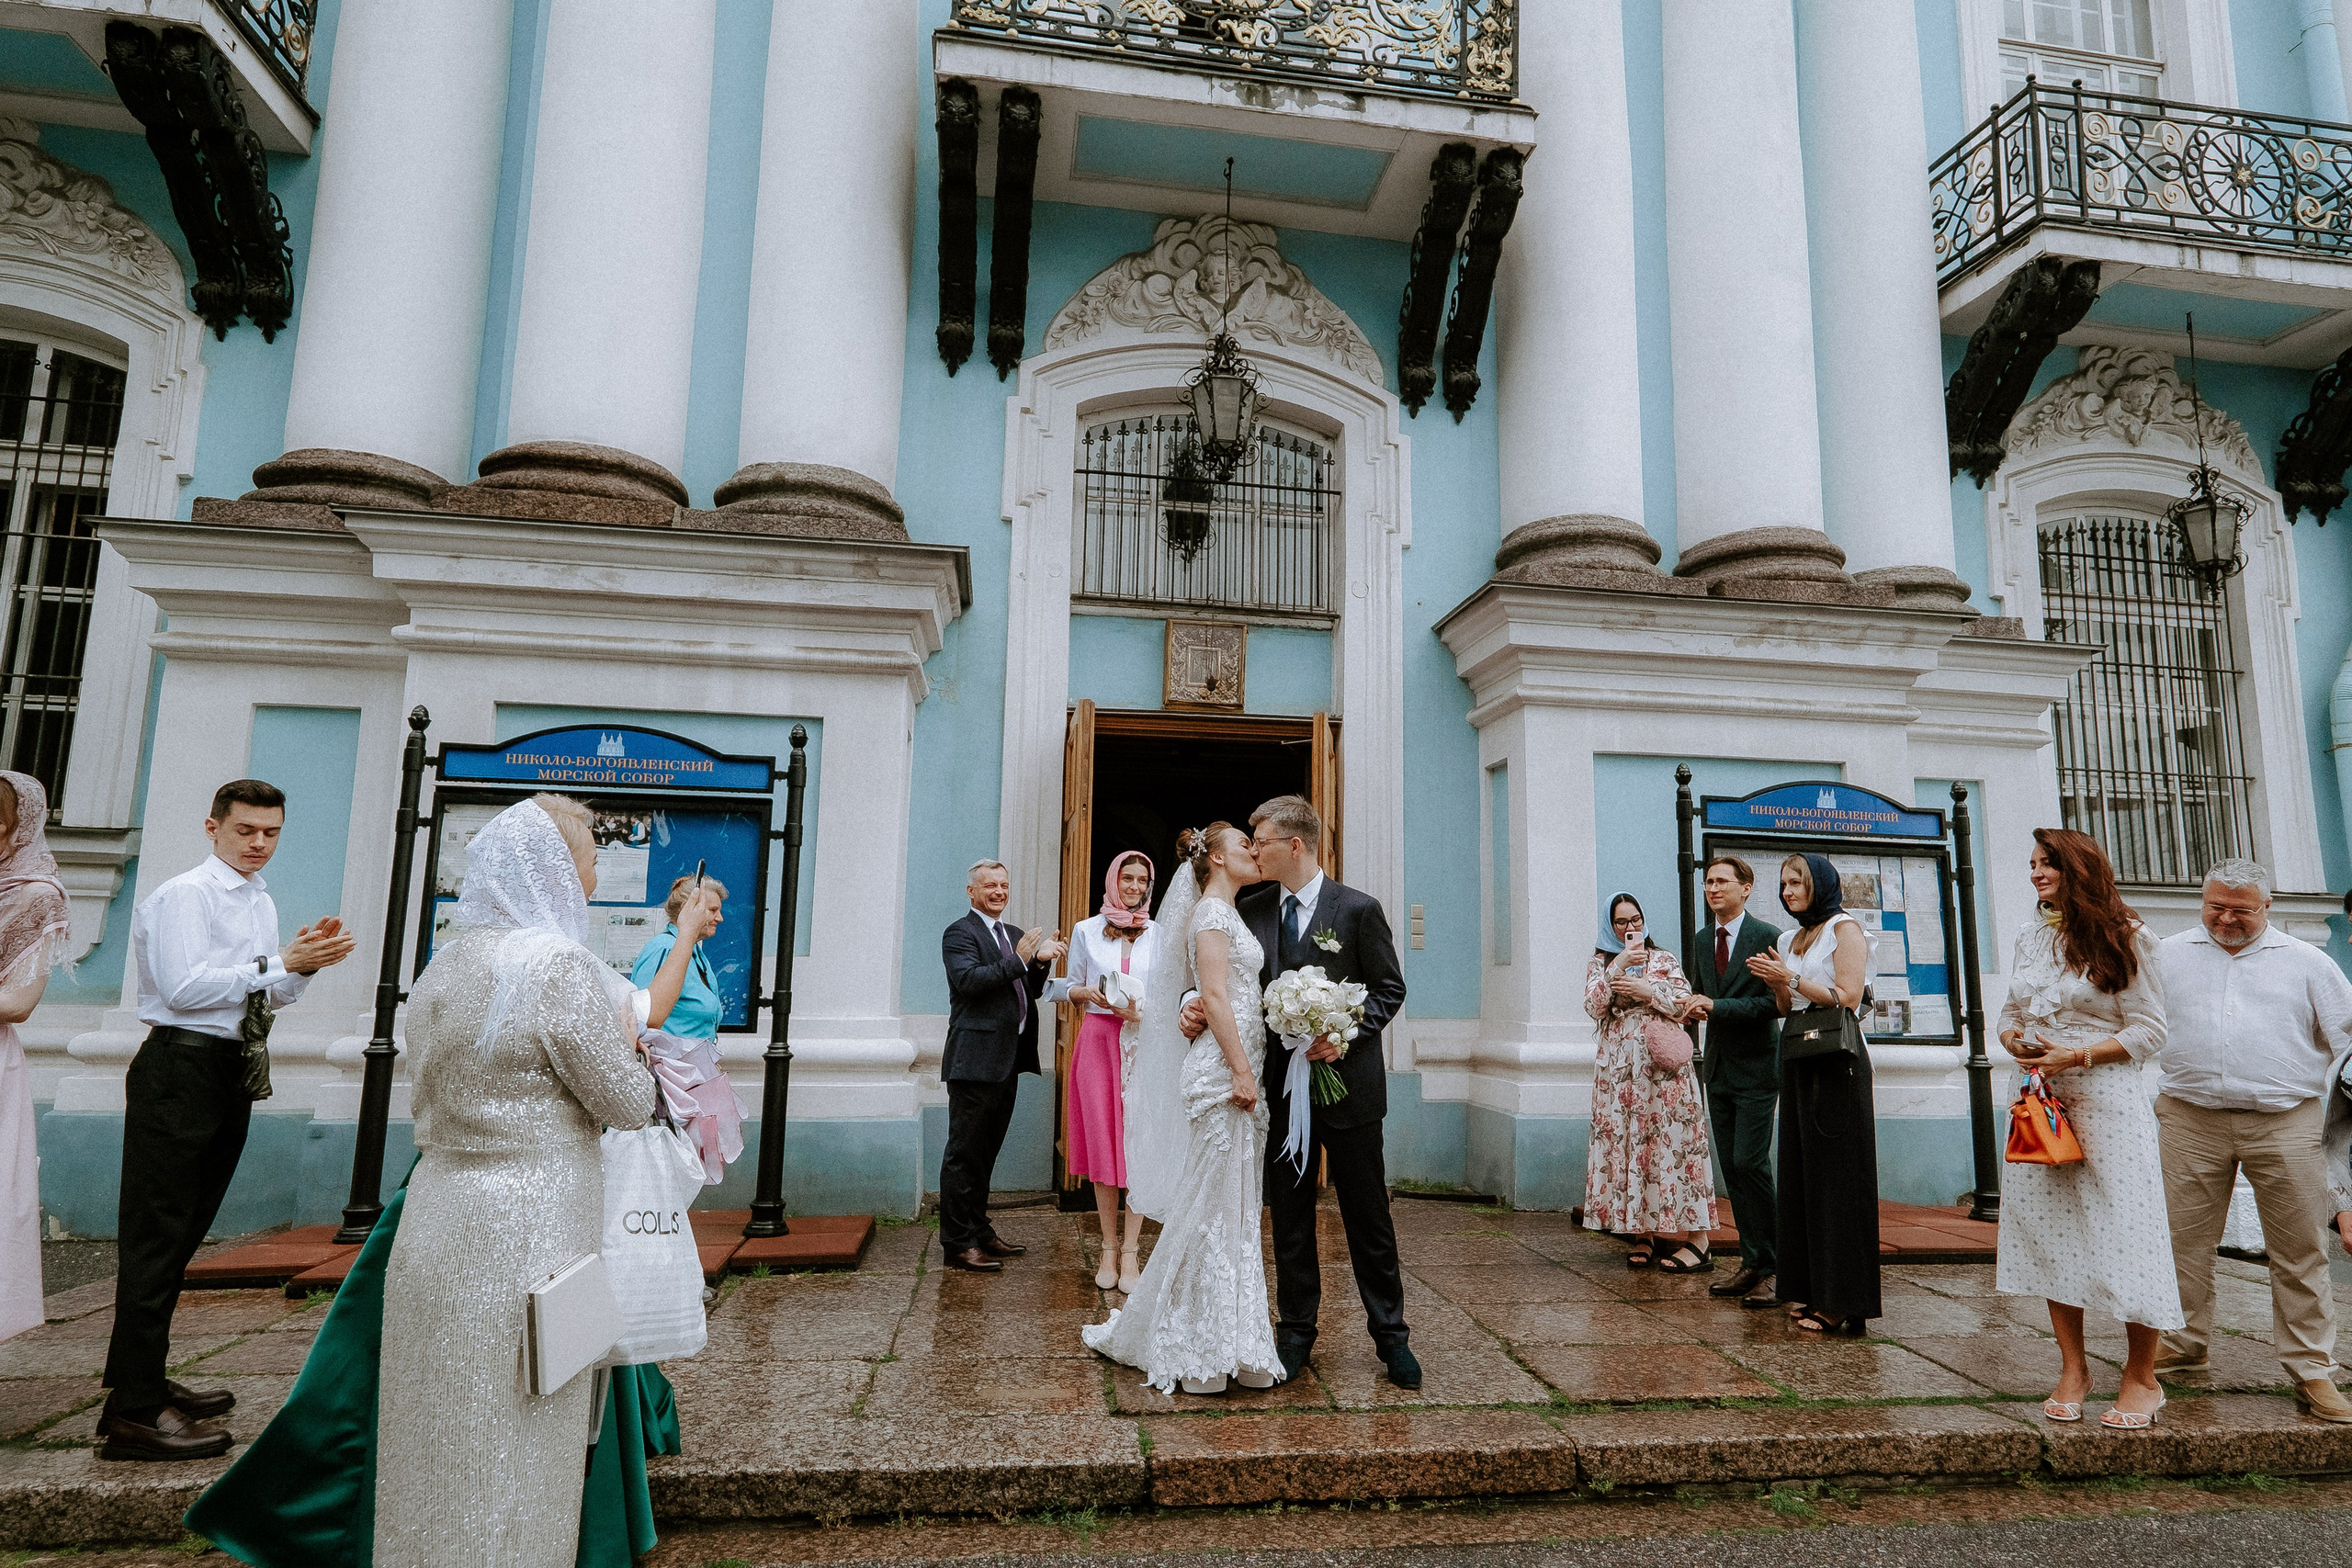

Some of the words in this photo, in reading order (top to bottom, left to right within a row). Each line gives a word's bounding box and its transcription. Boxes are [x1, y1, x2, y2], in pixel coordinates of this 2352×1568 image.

[504, 752, 715, 772] НИКОЛО-БОГОЯВЛЕНСКИЙ
[537, 768, 616, 782] МОРСКОЙ
[620, 772, 675, 784] СОБОР
[1749, 805, 1899, 822] НИКОЛО-БОГОЯВЛЕНСКИЙ
[1774, 818, 1834, 830] МОРСКОЙ
[1834, 821, 1872, 833] СОБОР
